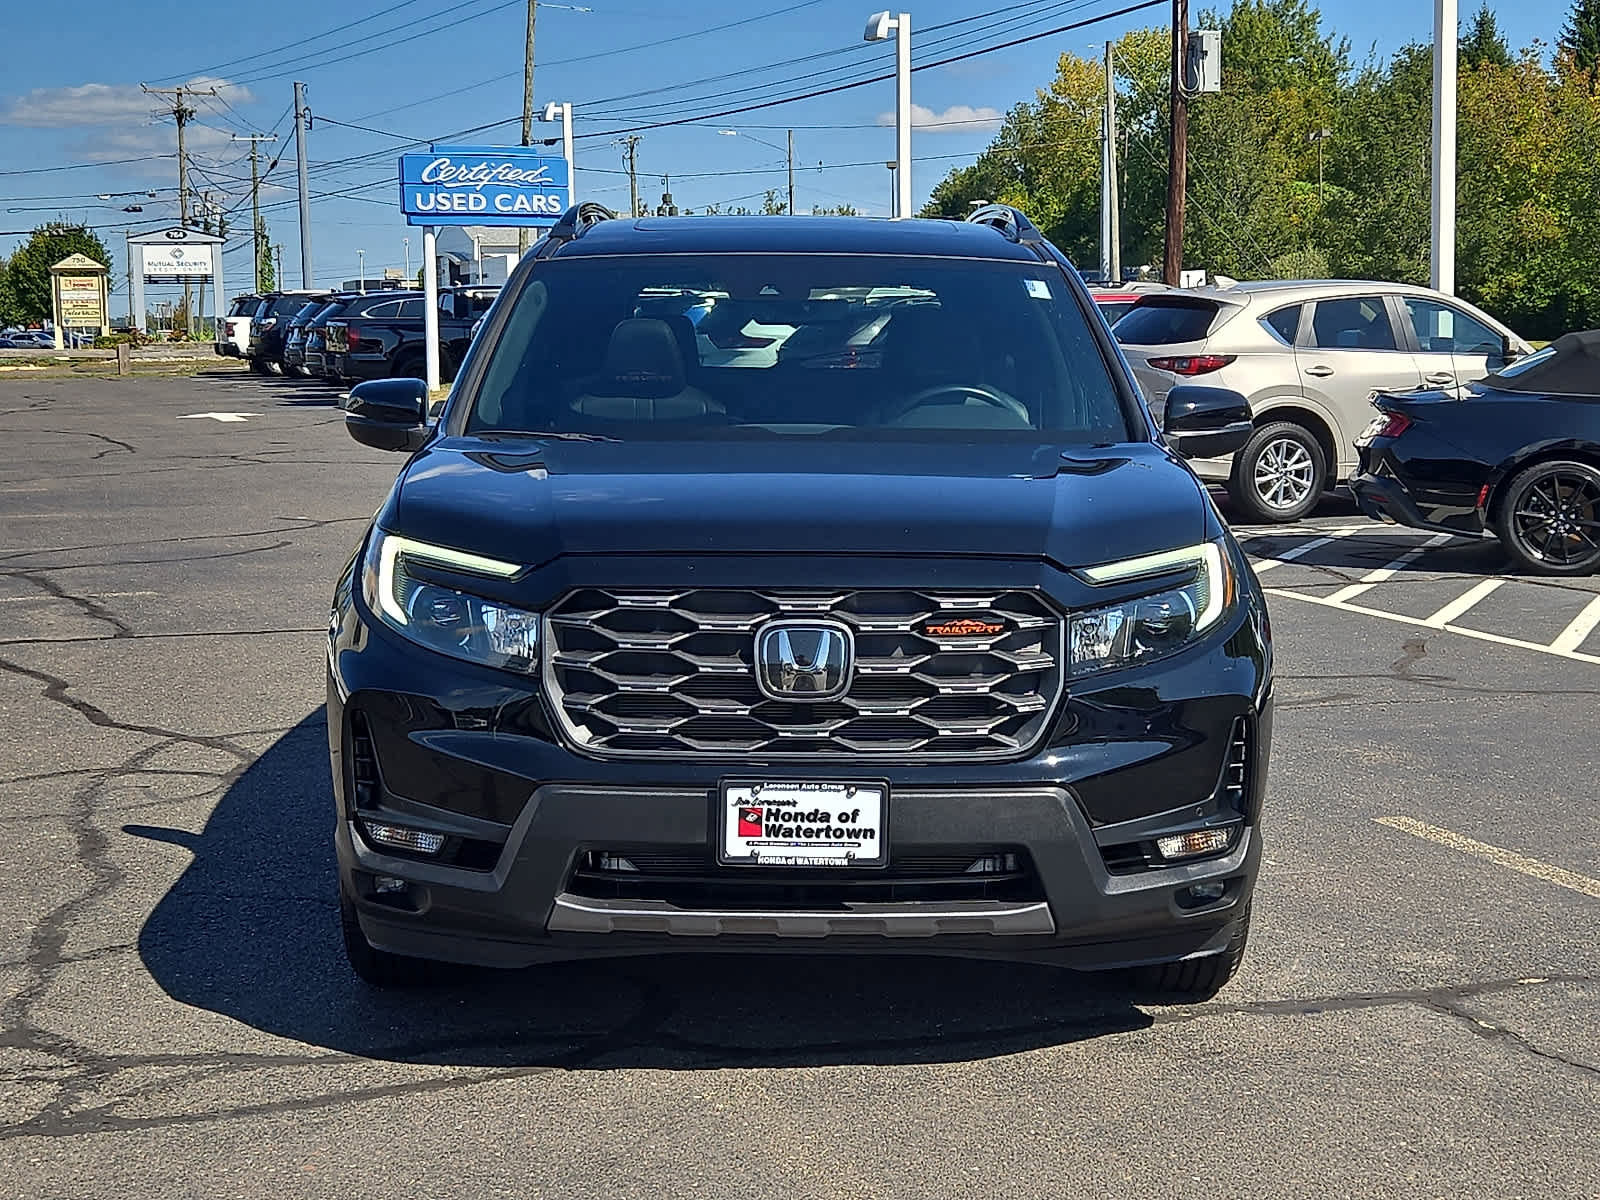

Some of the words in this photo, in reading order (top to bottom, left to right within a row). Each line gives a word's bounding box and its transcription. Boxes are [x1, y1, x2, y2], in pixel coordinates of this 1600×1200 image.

[421, 157, 553, 191] Certified
[415, 192, 487, 212] USED
[494, 193, 561, 213] CARS
[925, 624, 1004, 635] TRAILSPORT
[763, 783, 800, 791] Lorensen
[801, 783, 820, 791] Auto
[821, 783, 845, 792] Group
[765, 807, 831, 824] Honda
[837, 808, 860, 824] of
[764, 824, 876, 840] Watertown
[757, 855, 786, 865] HONDA
[786, 856, 796, 865] of
[796, 856, 849, 866] WATERTOWN
